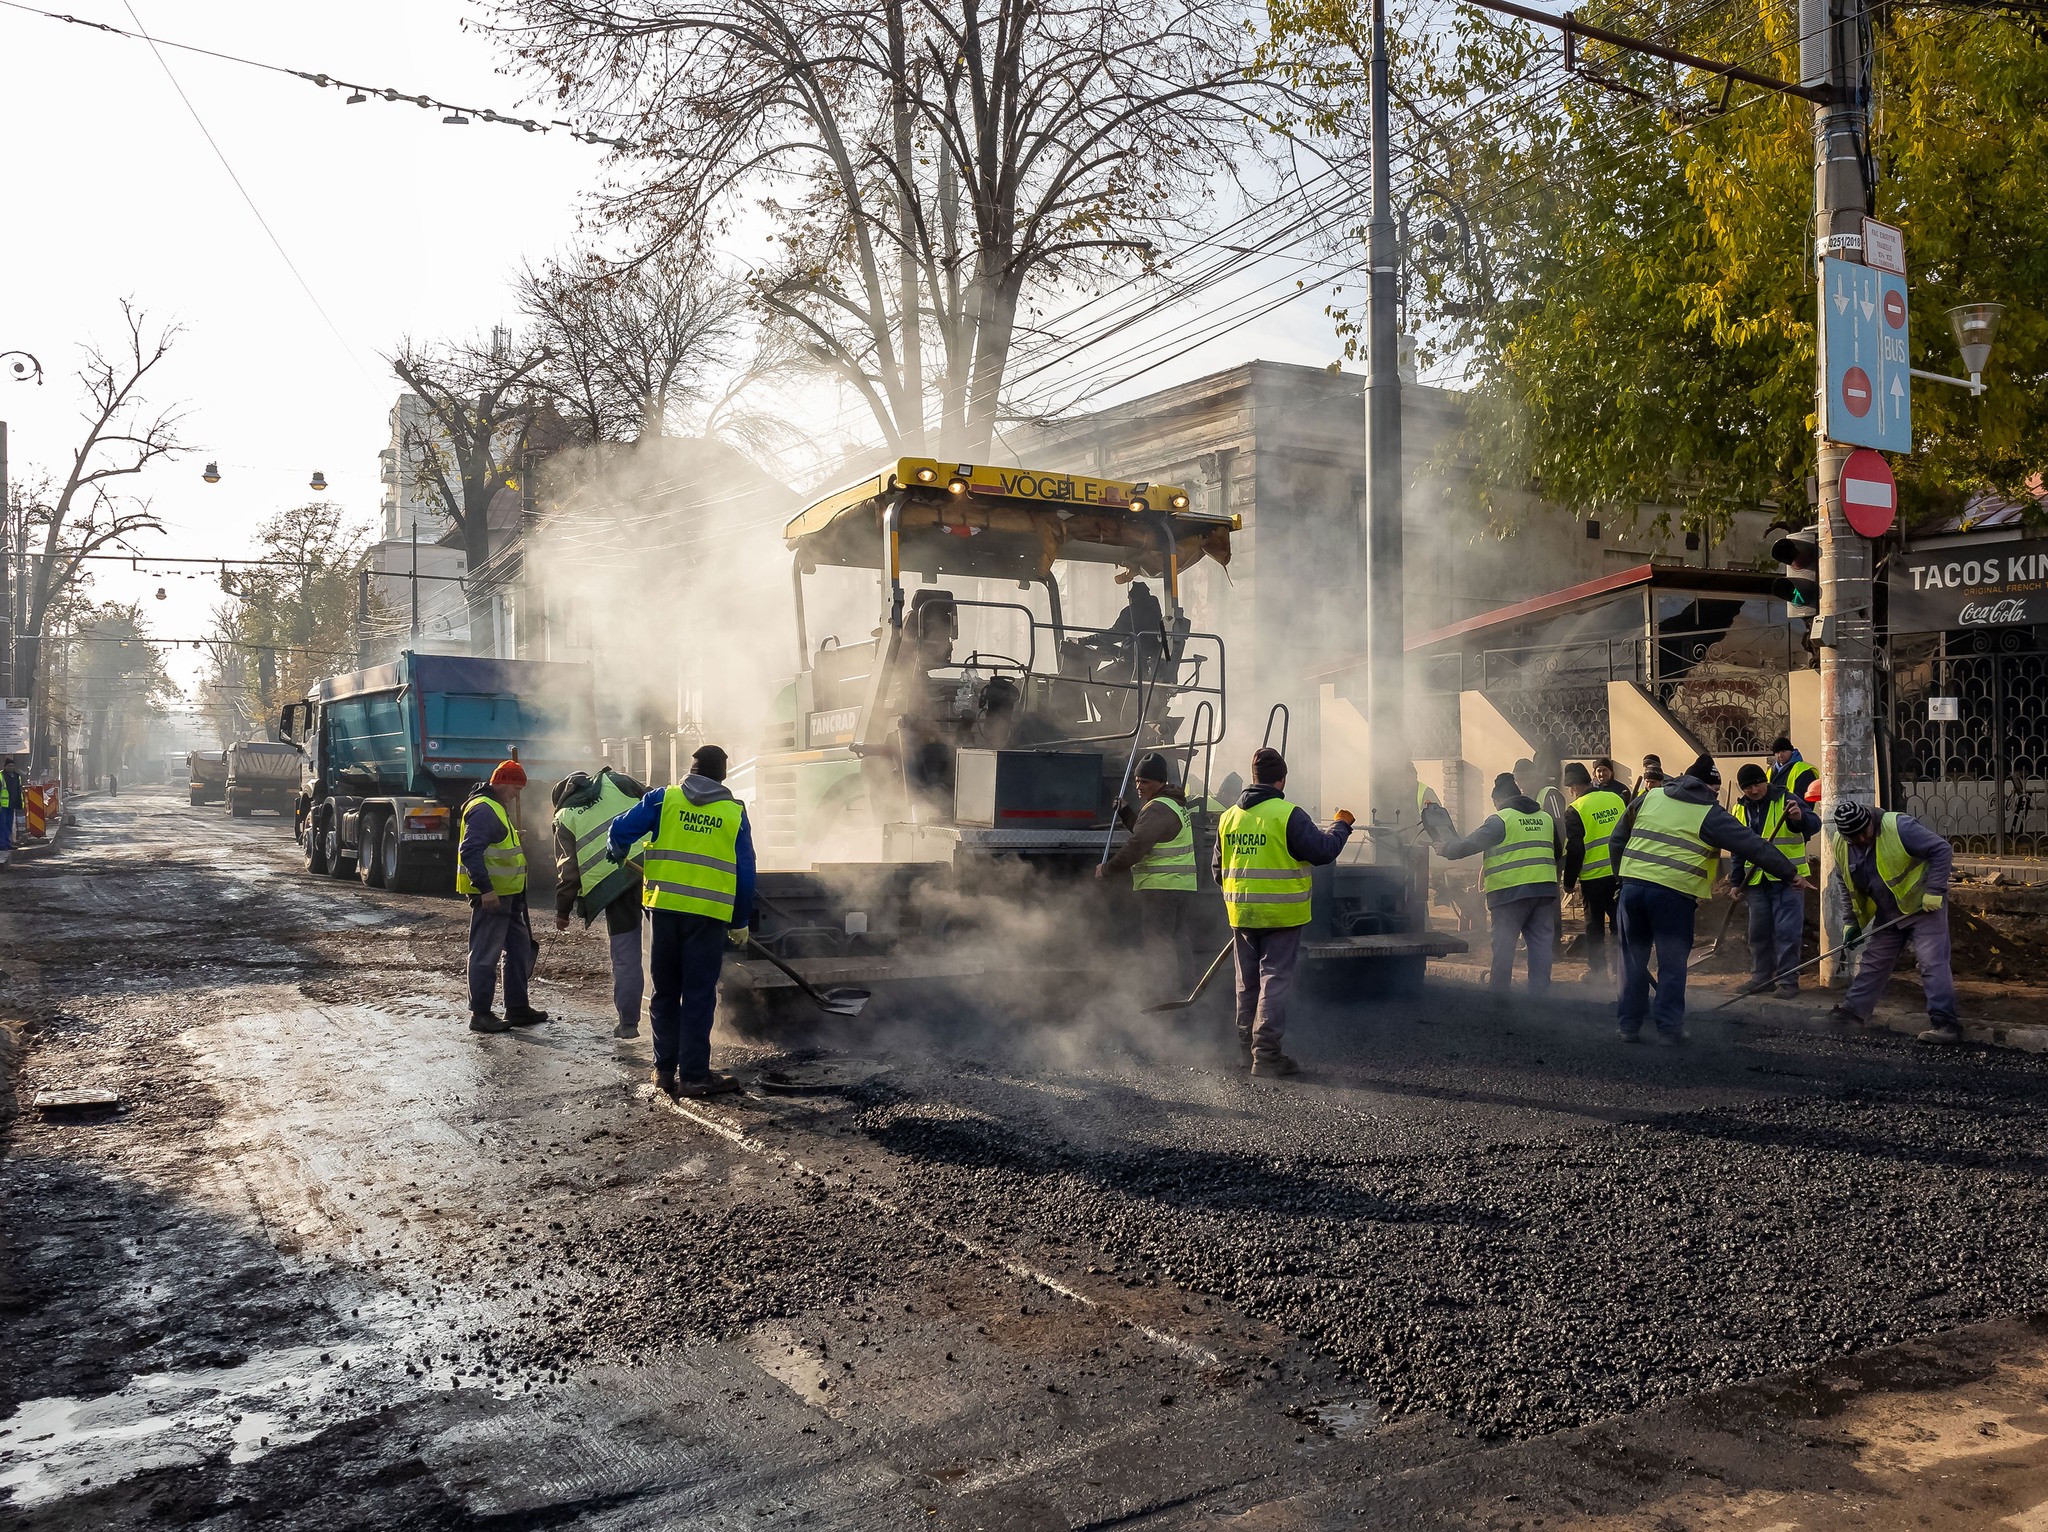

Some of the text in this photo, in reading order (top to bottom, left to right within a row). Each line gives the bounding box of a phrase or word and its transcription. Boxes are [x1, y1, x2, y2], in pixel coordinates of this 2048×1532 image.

[1884, 335, 1905, 364] BUS
[1909, 558, 2000, 591] TACOS
[1963, 586, 2003, 596] ORIGINAL
[2006, 582, 2042, 592] FRENCH
[811, 711, 856, 736] TANCRAD
[679, 810, 723, 828] TANCRAD
[1591, 807, 1619, 820] TANCRAD
[683, 823, 713, 835] GALATI
[1518, 818, 1544, 826] TANCRAD
[1225, 833, 1267, 846] TANCRAD
